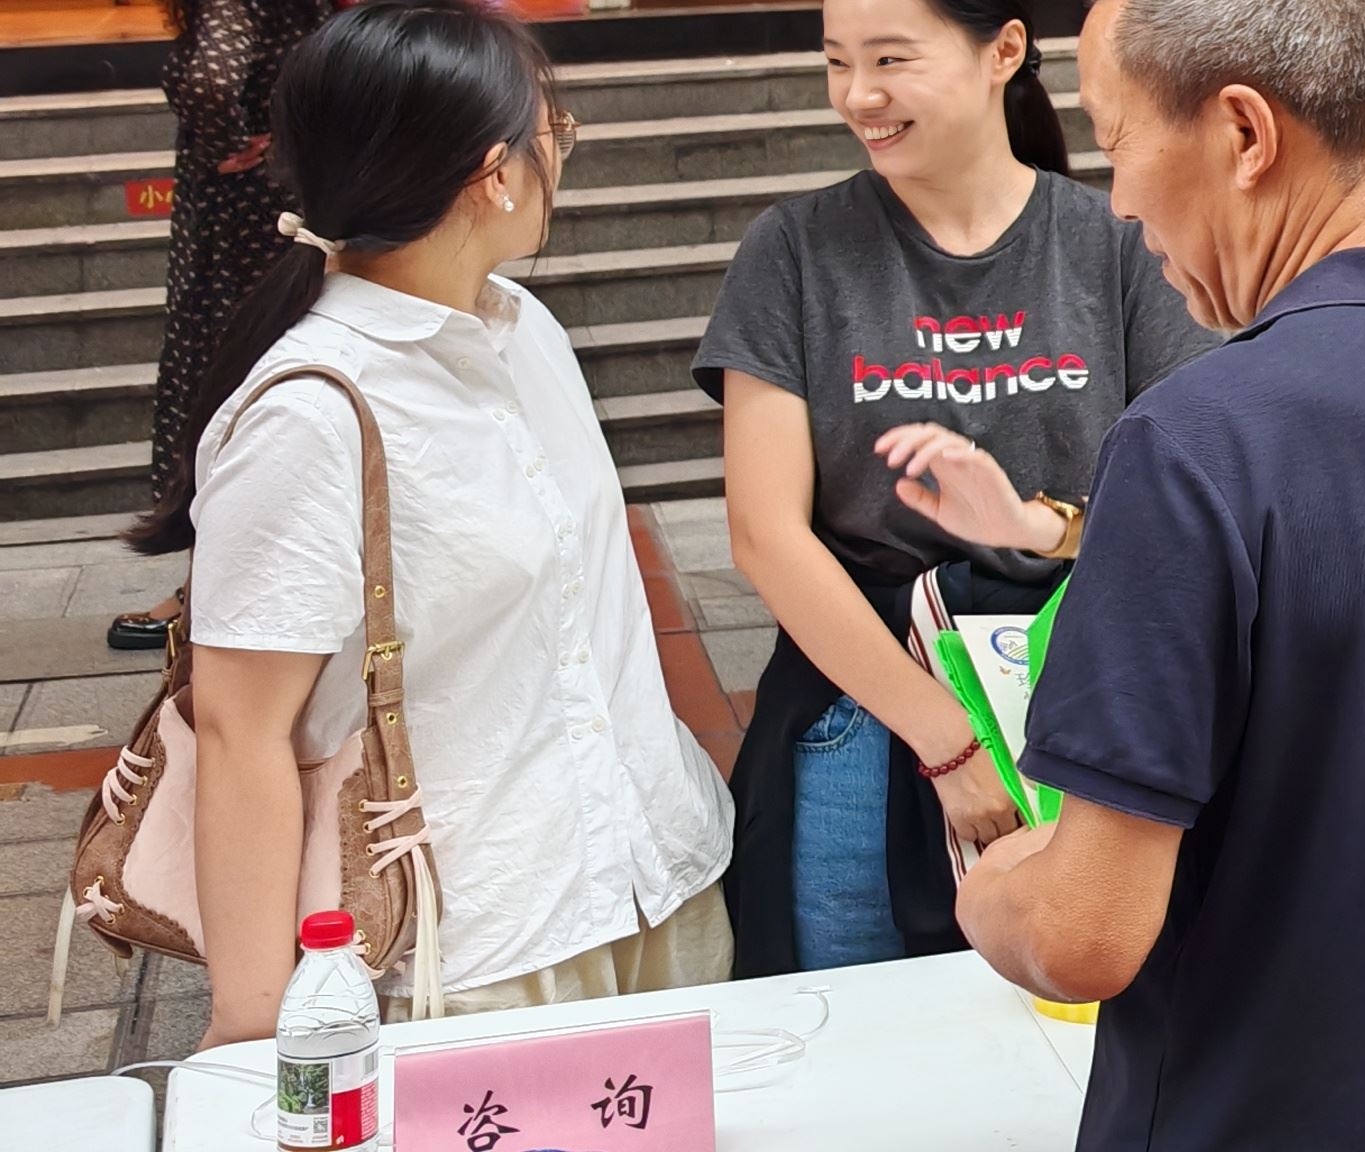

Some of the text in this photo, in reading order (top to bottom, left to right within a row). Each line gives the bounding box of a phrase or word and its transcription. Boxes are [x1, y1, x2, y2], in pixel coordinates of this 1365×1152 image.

[913, 310, 1027, 354] new
[852, 352, 1090, 404] balance
[457, 1074, 654, 1152] 咨询
